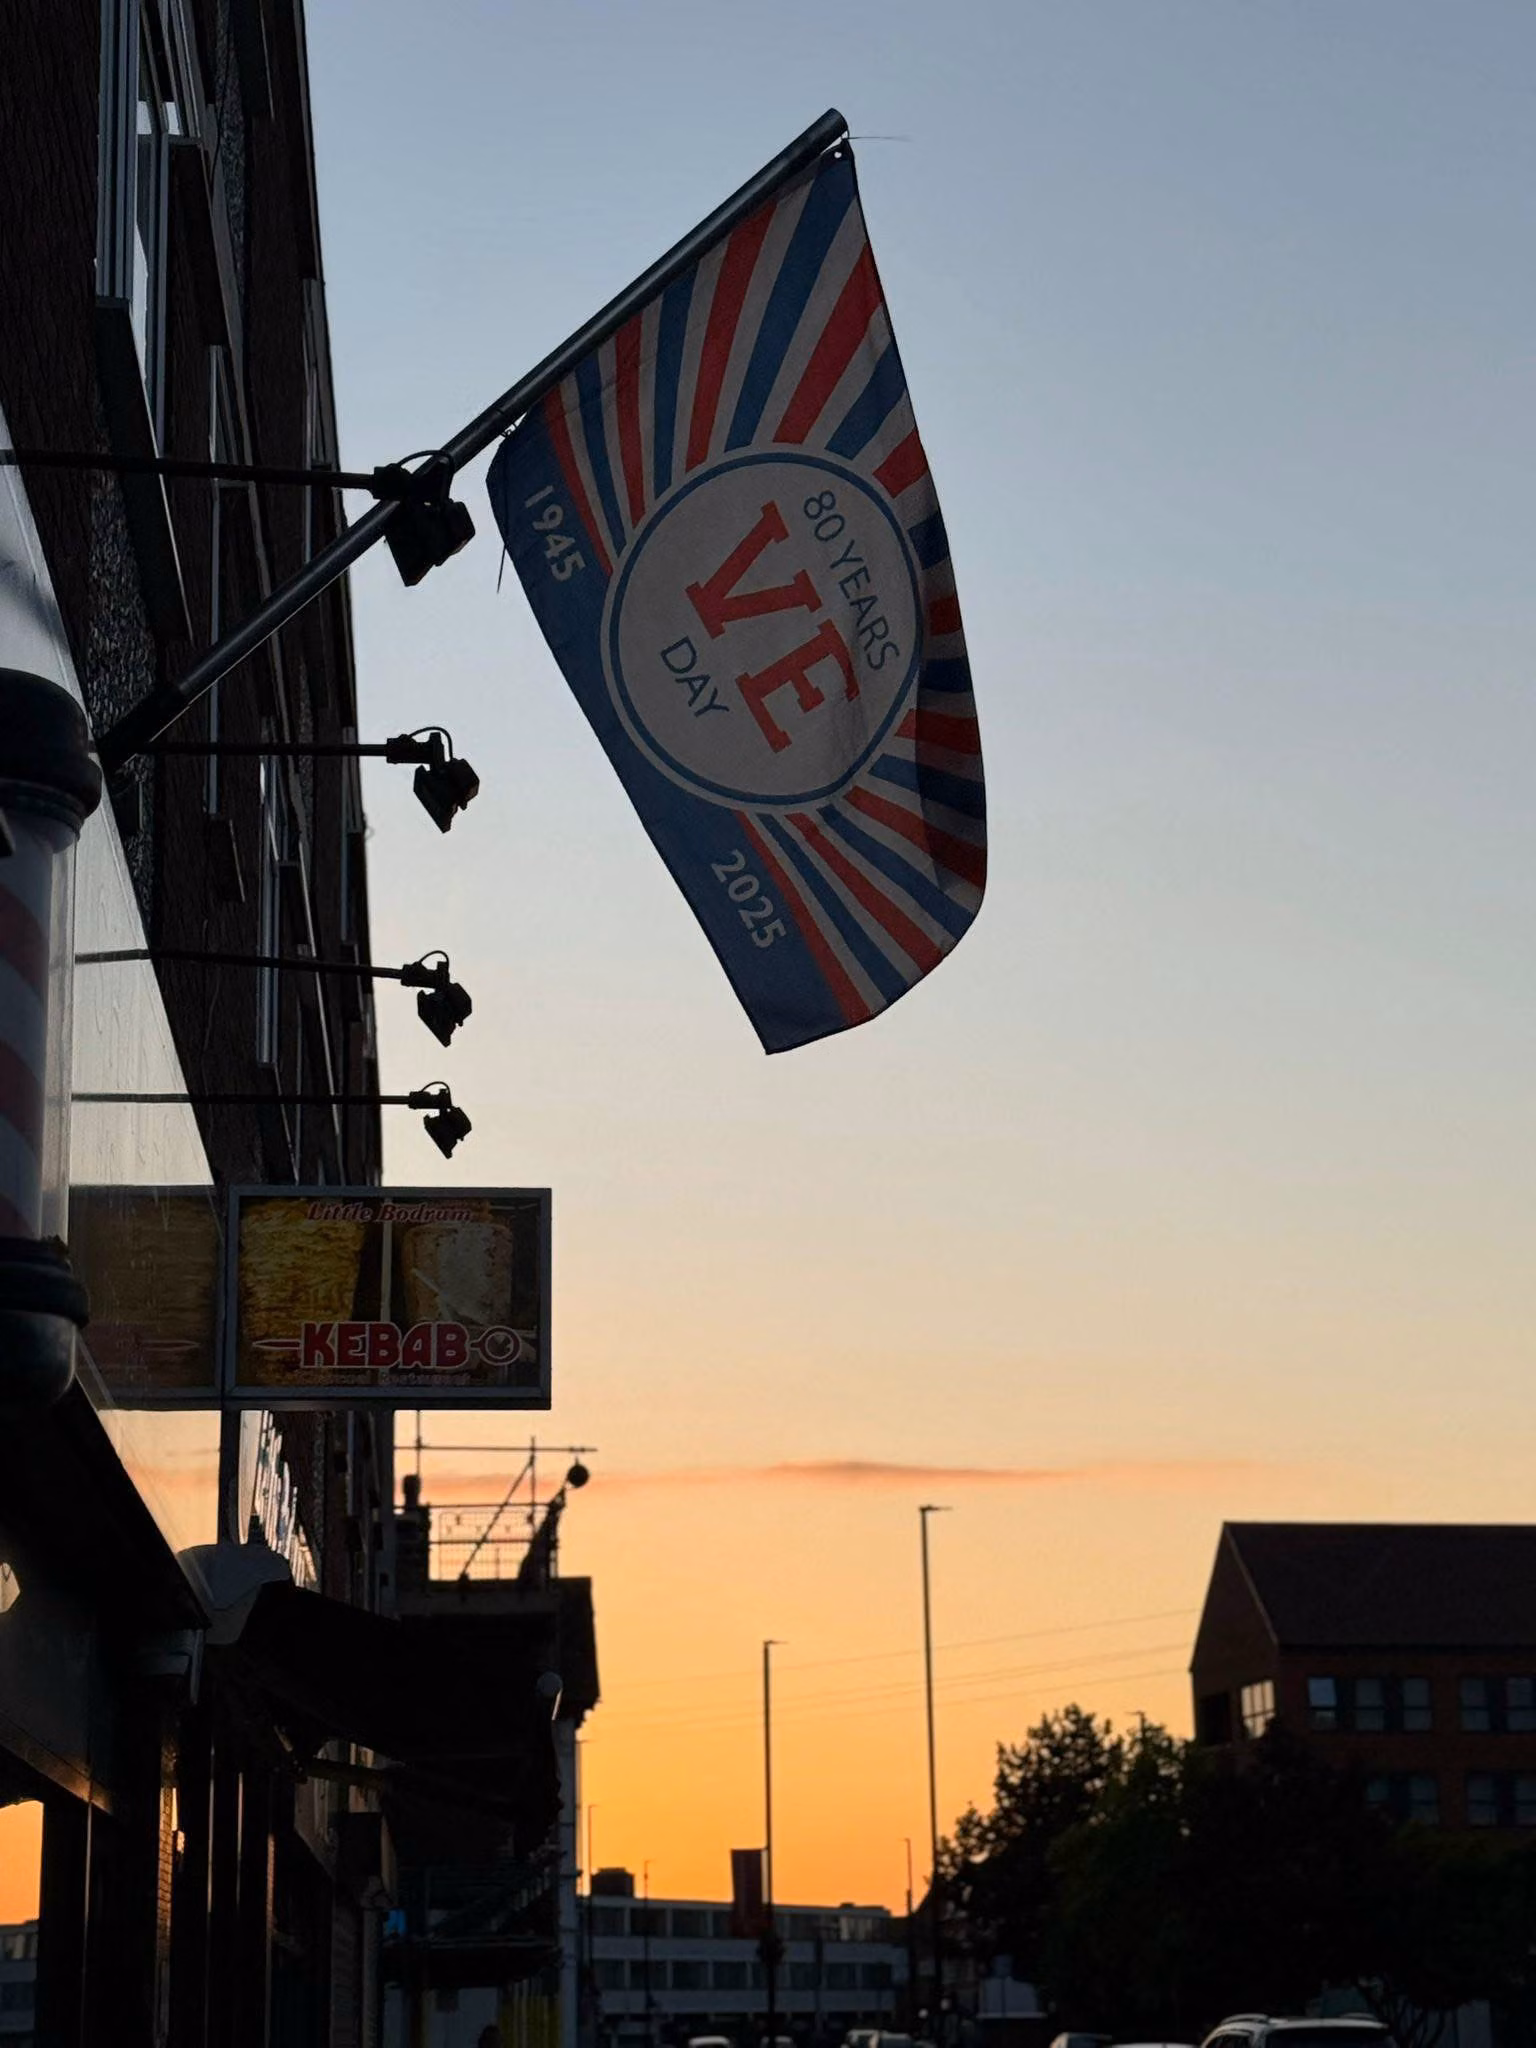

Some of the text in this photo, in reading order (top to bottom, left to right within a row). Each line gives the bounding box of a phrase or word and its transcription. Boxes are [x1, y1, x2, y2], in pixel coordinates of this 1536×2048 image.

[524, 484, 586, 582] 1945
[803, 489, 900, 671] 80 YEARS
[685, 501, 860, 754] VE
[660, 636, 729, 718] DAY
[711, 848, 787, 948] 2025
[307, 1202, 472, 1223] Little Bodrum
[303, 1322, 470, 1367] KEBAB
